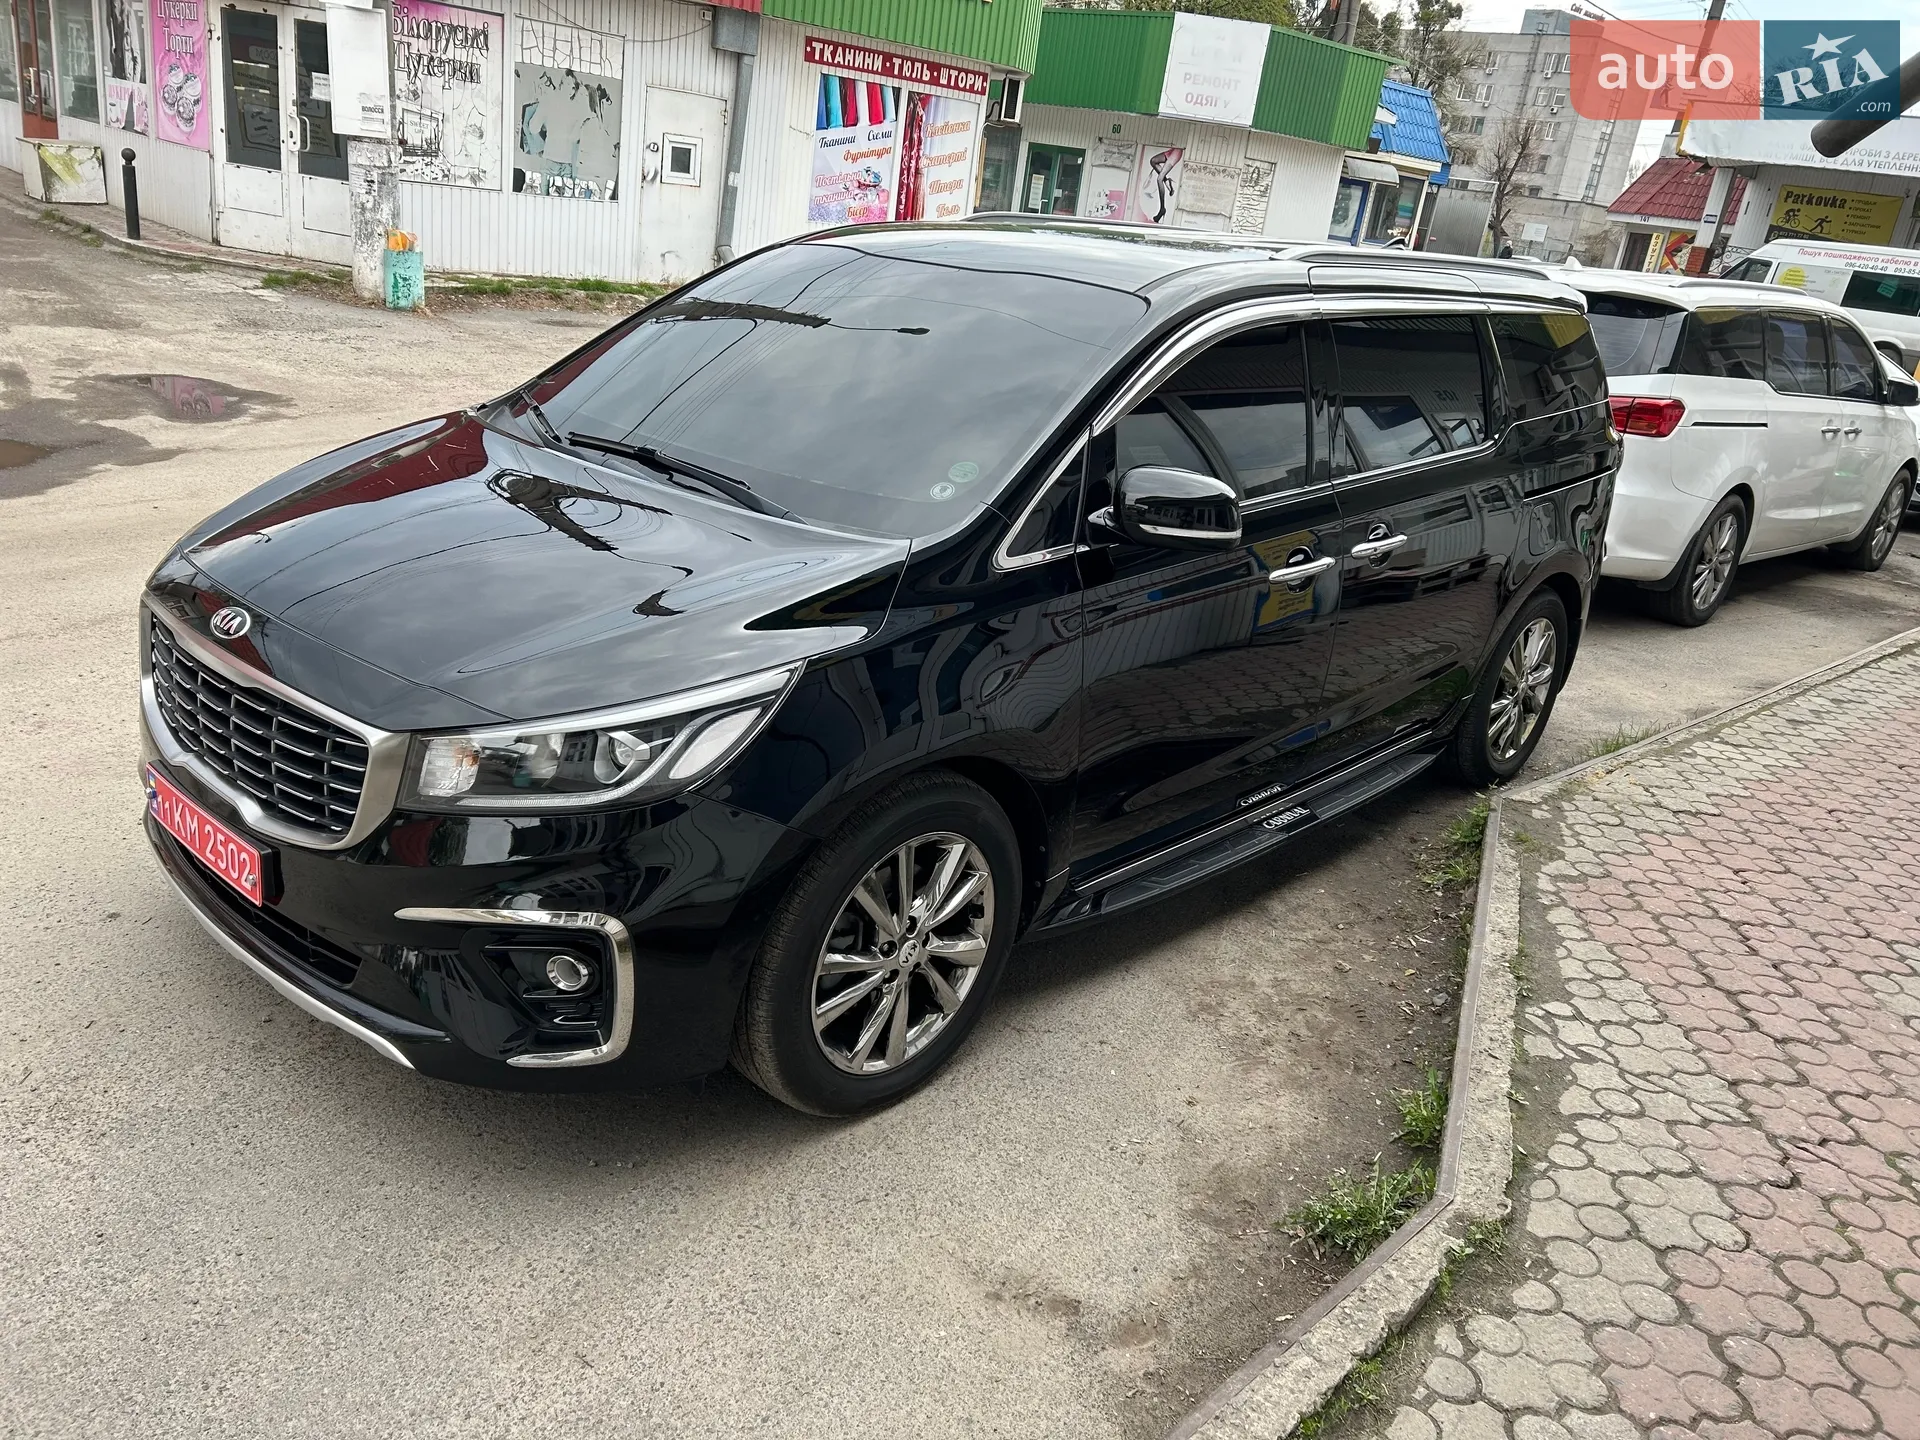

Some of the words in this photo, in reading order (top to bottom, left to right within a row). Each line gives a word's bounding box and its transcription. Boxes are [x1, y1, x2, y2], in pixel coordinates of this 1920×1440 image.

[157, 0, 198, 27] Цукерки
[162, 27, 194, 59] Торти
[394, 40, 481, 90] Цукерки
[812, 41, 883, 72] ТКАНИНИ
[893, 58, 931, 81] ТЮЛЬ
[940, 67, 983, 92] ШТОРИ
[1183, 72, 1241, 92] РЕМОНТ
[1111, 124, 1122, 134] 60
[819, 135, 856, 149] Тканини
[867, 129, 893, 142] Схеми
[843, 146, 892, 164] Фурнітура
[1840, 156, 1864, 167] ДЛЯ
[1884, 149, 1892, 159] З
[1892, 151, 1920, 162] ДЕРЕ
[815, 170, 862, 188] Постільна
[928, 178, 964, 195] Штори
[814, 190, 854, 206] тканина
[1783, 190, 1847, 209] Parkovka
[847, 206, 869, 218] Бісер
[1640, 215, 1650, 223] 141
[1797, 248, 1822, 258] Пошук
[1823, 251, 1879, 263] пошкодженого
[1880, 257, 1912, 267] кабелю
[1844, 262, 1888, 272] 096-420-40-40
[213, 609, 243, 635] KIA
[1262, 806, 1310, 829] CARNIVAL
[157, 794, 200, 849] 11KM
[204, 823, 252, 892] 2502
[902, 943, 919, 963] KIA
